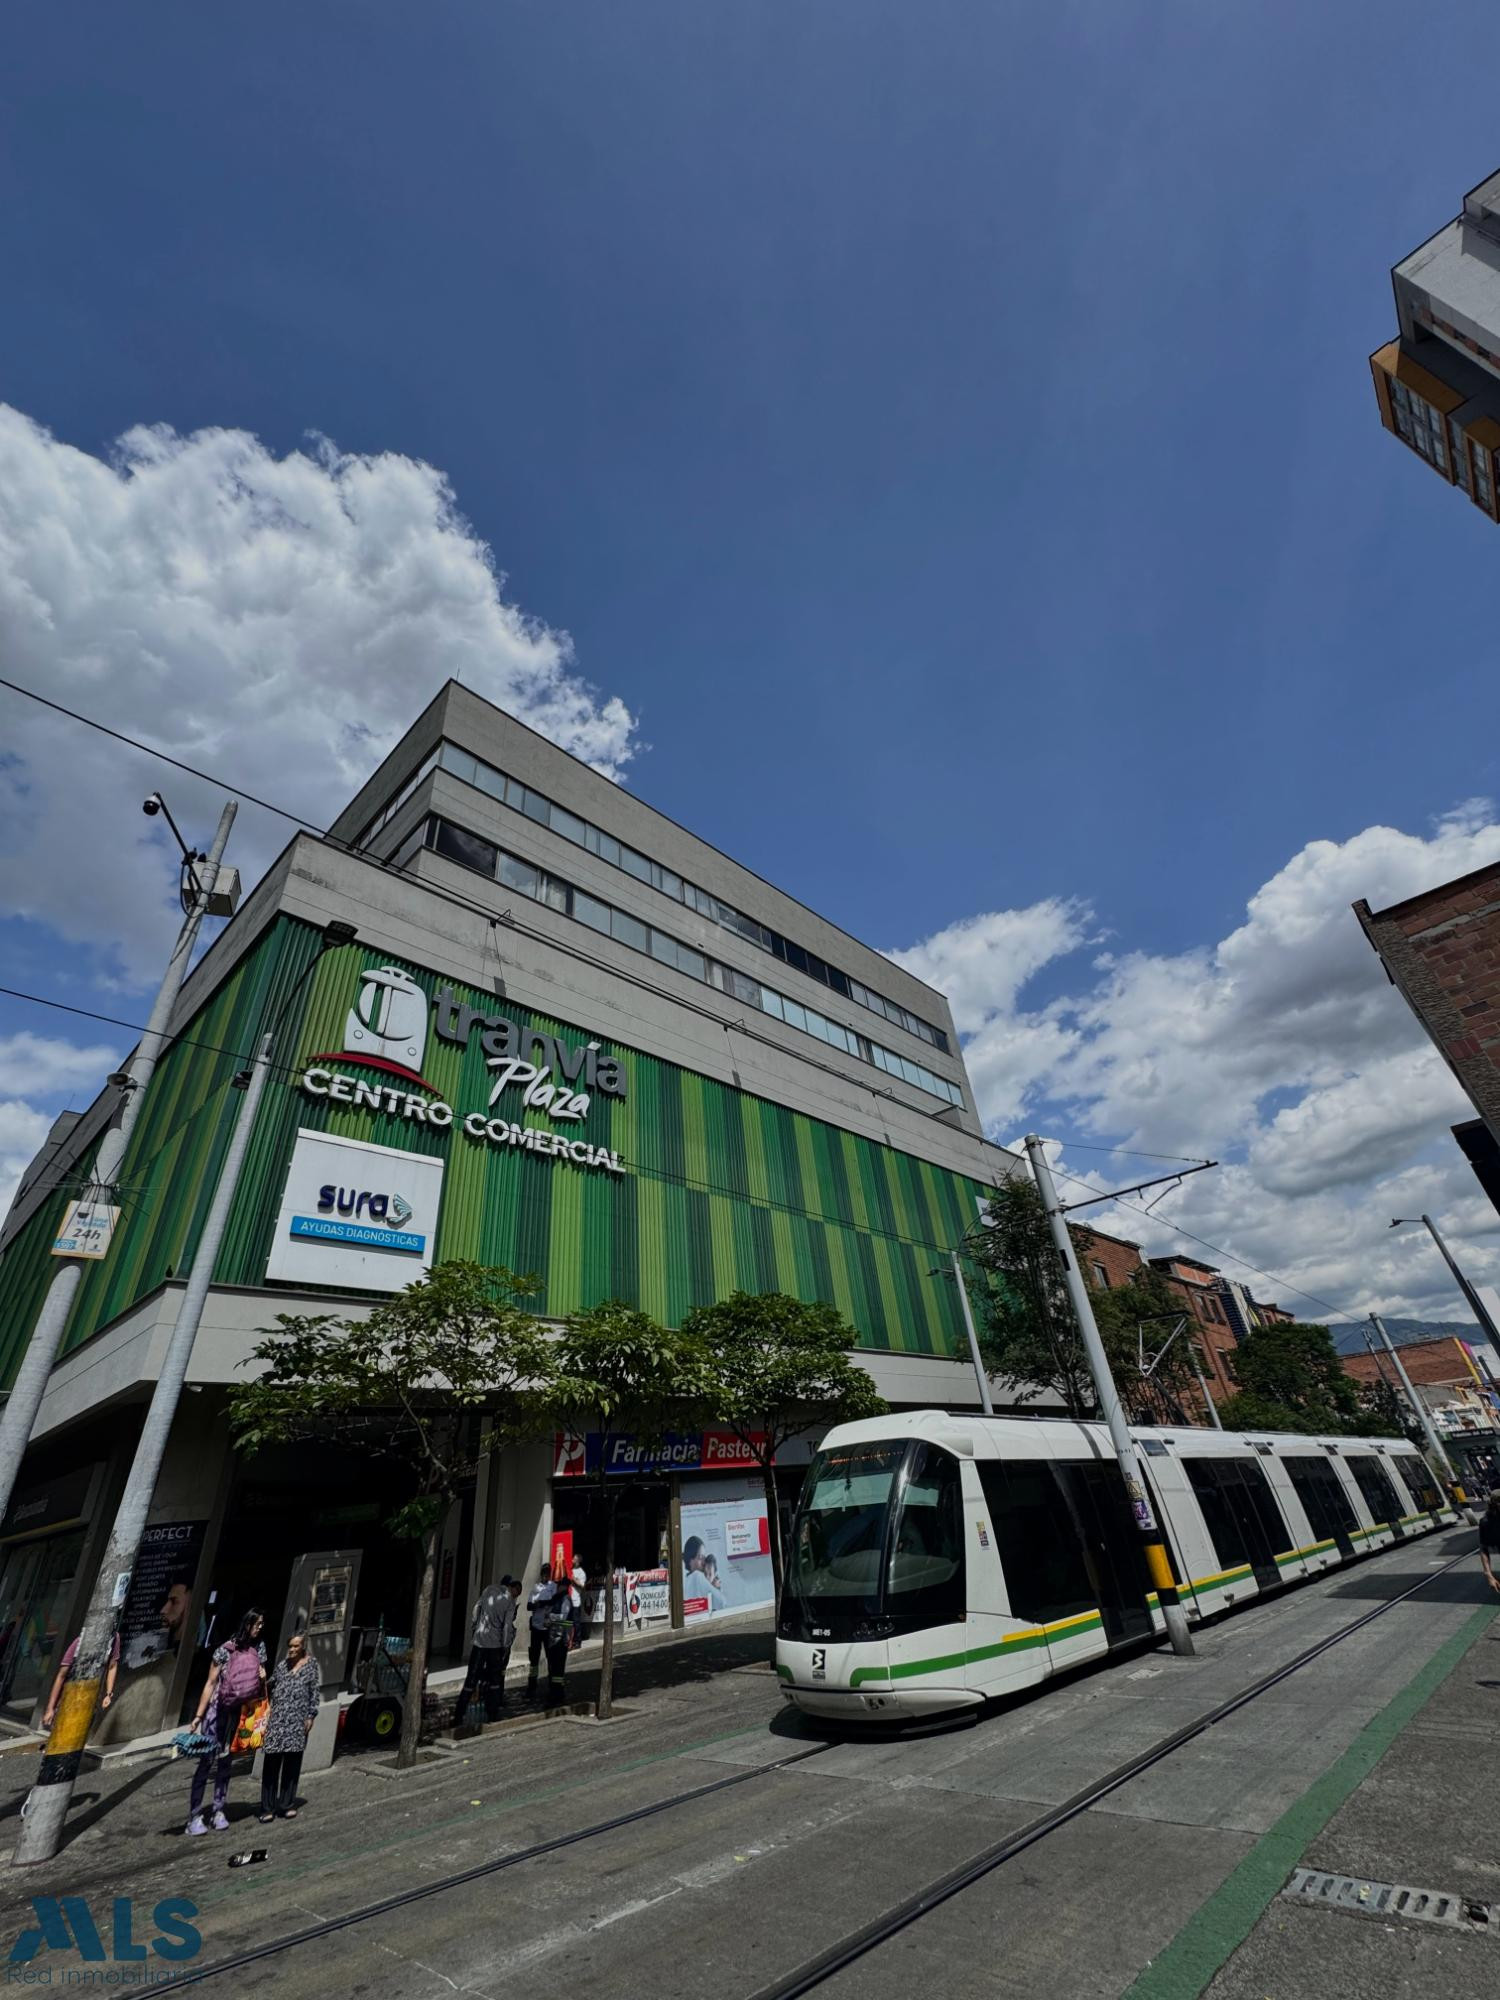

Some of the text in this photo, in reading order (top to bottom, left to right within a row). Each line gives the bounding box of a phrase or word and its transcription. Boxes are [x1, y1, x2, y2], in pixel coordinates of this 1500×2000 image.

[433, 986, 627, 1098] tranvía
[486, 1054, 591, 1119] Plaza
[303, 1068, 626, 1174] CENTRO COMERCIAL
[317, 1185, 389, 1217] sura
[72, 1228, 101, 1240] 24h
[300, 1221, 419, 1247] AYUDAS DIAGNÓSTICAS
[707, 1437, 767, 1459] Pasteur
